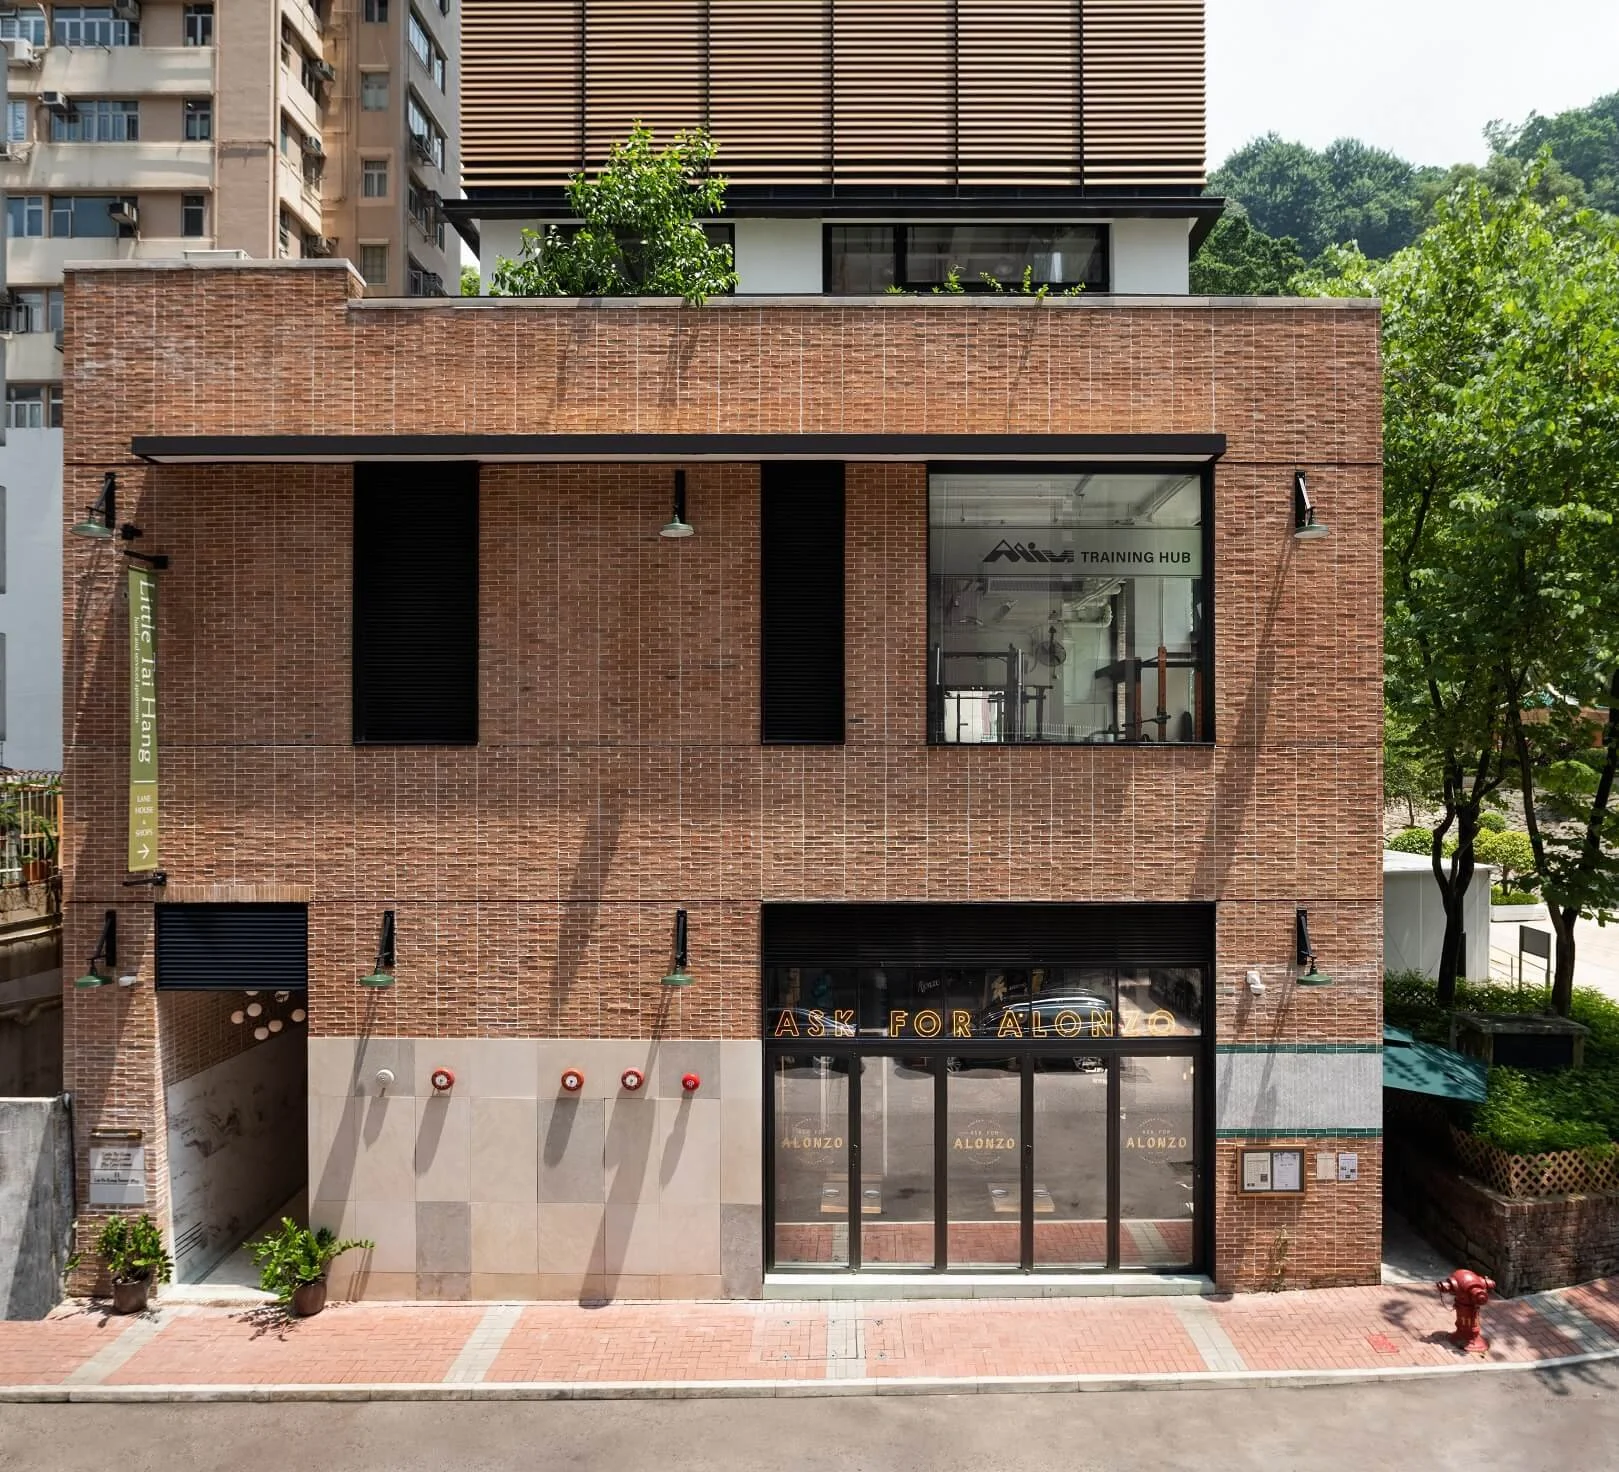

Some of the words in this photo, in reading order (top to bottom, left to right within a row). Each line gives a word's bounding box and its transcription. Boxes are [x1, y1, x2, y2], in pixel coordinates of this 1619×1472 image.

[1081, 551, 1154, 564] TRAINING
[1159, 551, 1191, 564] HUB
[140, 580, 155, 643] Little
[141, 652, 156, 687] Tai
[138, 697, 156, 764] Hang
[135, 806, 153, 814] HOUSE
[774, 1009, 857, 1038] ASK
[890, 1009, 971, 1038] FOR
[997, 1009, 1176, 1038] ALONZO
[782, 1136, 843, 1149] ALONZO
[953, 1137, 1015, 1149] ALONZO
[1126, 1136, 1187, 1149] ALONZO
